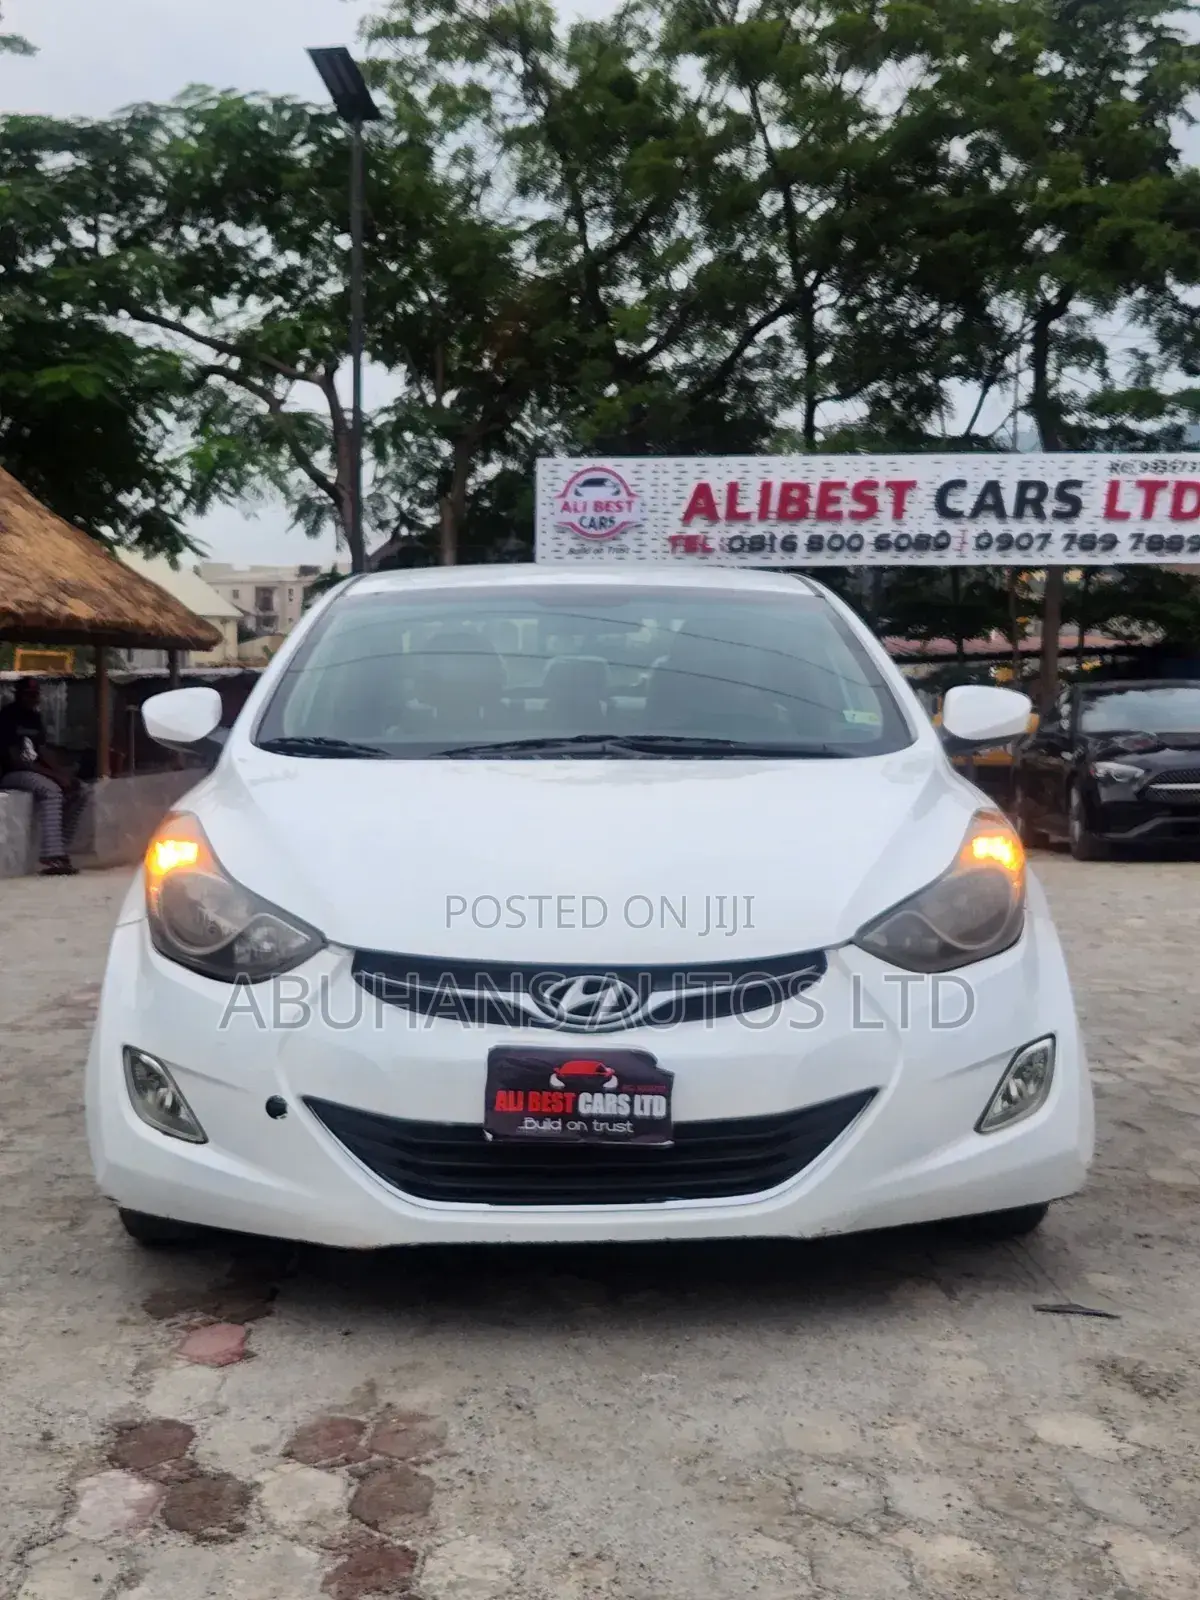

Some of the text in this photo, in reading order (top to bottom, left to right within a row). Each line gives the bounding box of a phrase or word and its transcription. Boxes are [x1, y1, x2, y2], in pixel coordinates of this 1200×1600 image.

[560, 501, 634, 513] ALI BEST
[682, 479, 1200, 524] ALIBEST CARS LTD
[579, 516, 616, 530] CARS
[807, 533, 864, 553] 800
[974, 532, 1052, 551] 0907
[495, 1091, 666, 1117] ALI BEST CARS LTD
[566, 1120, 588, 1131] on
[593, 1120, 634, 1132] trust
